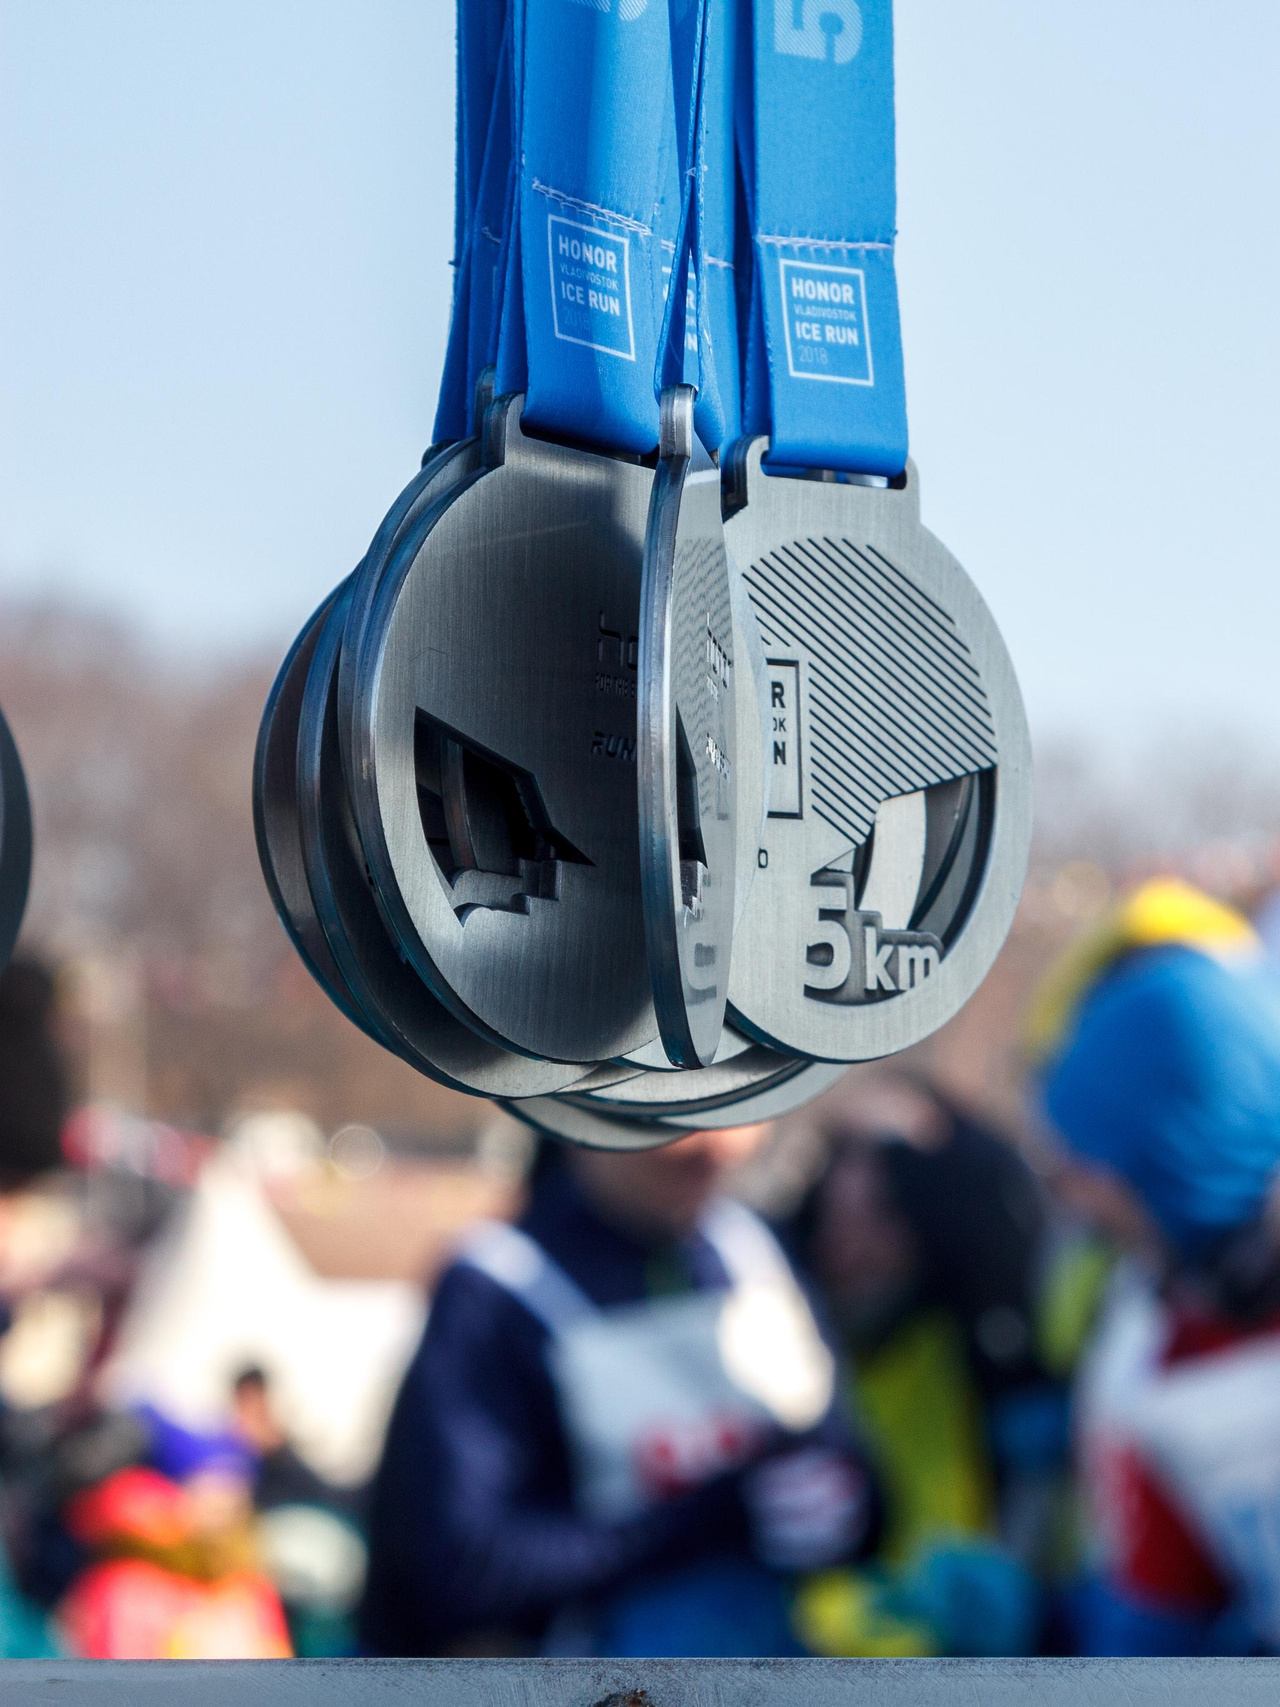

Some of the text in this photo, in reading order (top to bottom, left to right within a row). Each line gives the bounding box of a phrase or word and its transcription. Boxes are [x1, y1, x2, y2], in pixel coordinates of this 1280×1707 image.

[559, 234, 617, 273] HONOR
[561, 263, 619, 290] VLADIVOSTOK
[561, 281, 620, 316] ICE RUN
[792, 277, 855, 304] HONOR
[794, 304, 857, 322] VLADIVOSTOK
[795, 321, 859, 345] ICE RUN
[798, 345, 828, 365] 2018
[803, 886, 940, 990] 5 km
